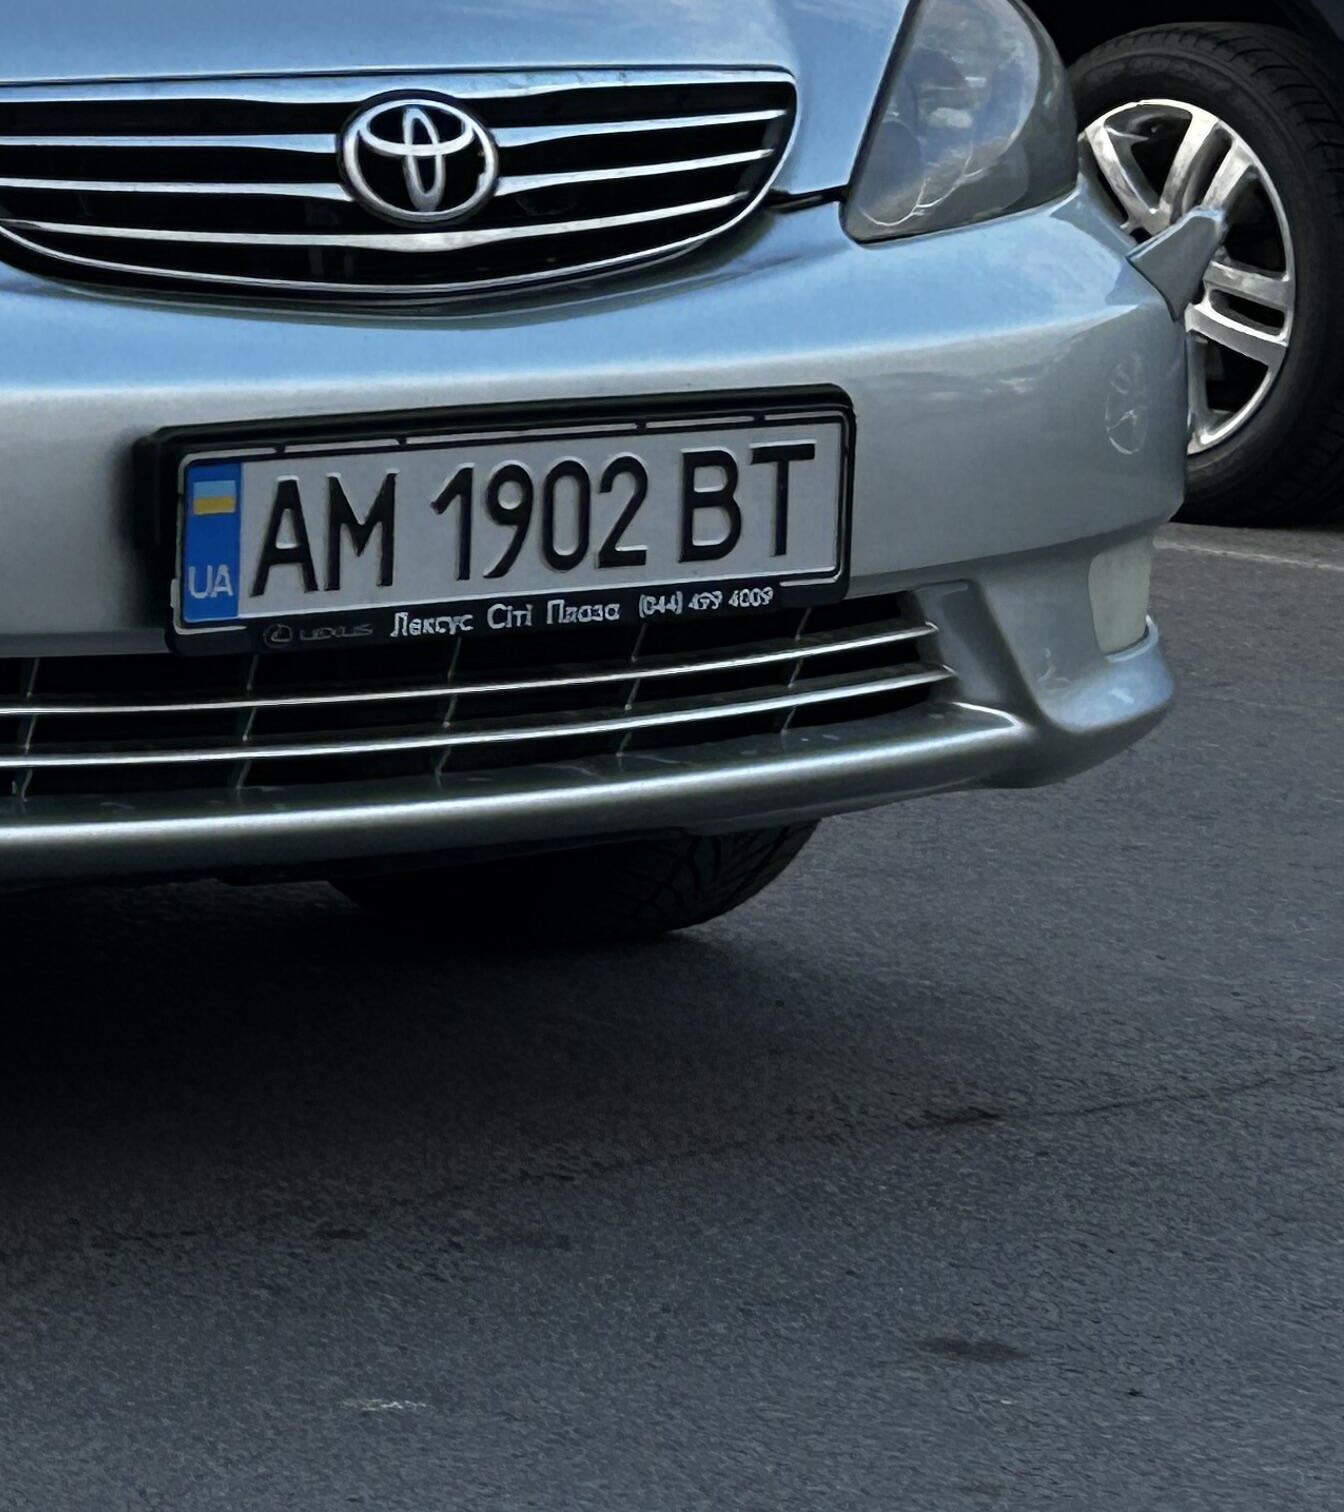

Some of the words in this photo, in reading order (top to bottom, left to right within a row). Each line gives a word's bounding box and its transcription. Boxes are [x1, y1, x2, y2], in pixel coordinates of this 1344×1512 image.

[249, 472, 398, 598] AM
[429, 455, 649, 583] 1902
[678, 440, 817, 564] BT
[187, 564, 234, 600] UA
[390, 612, 474, 640] Лексус
[486, 603, 533, 631] Сіті
[545, 599, 621, 627] Плаза
[638, 592, 683, 620] (044)
